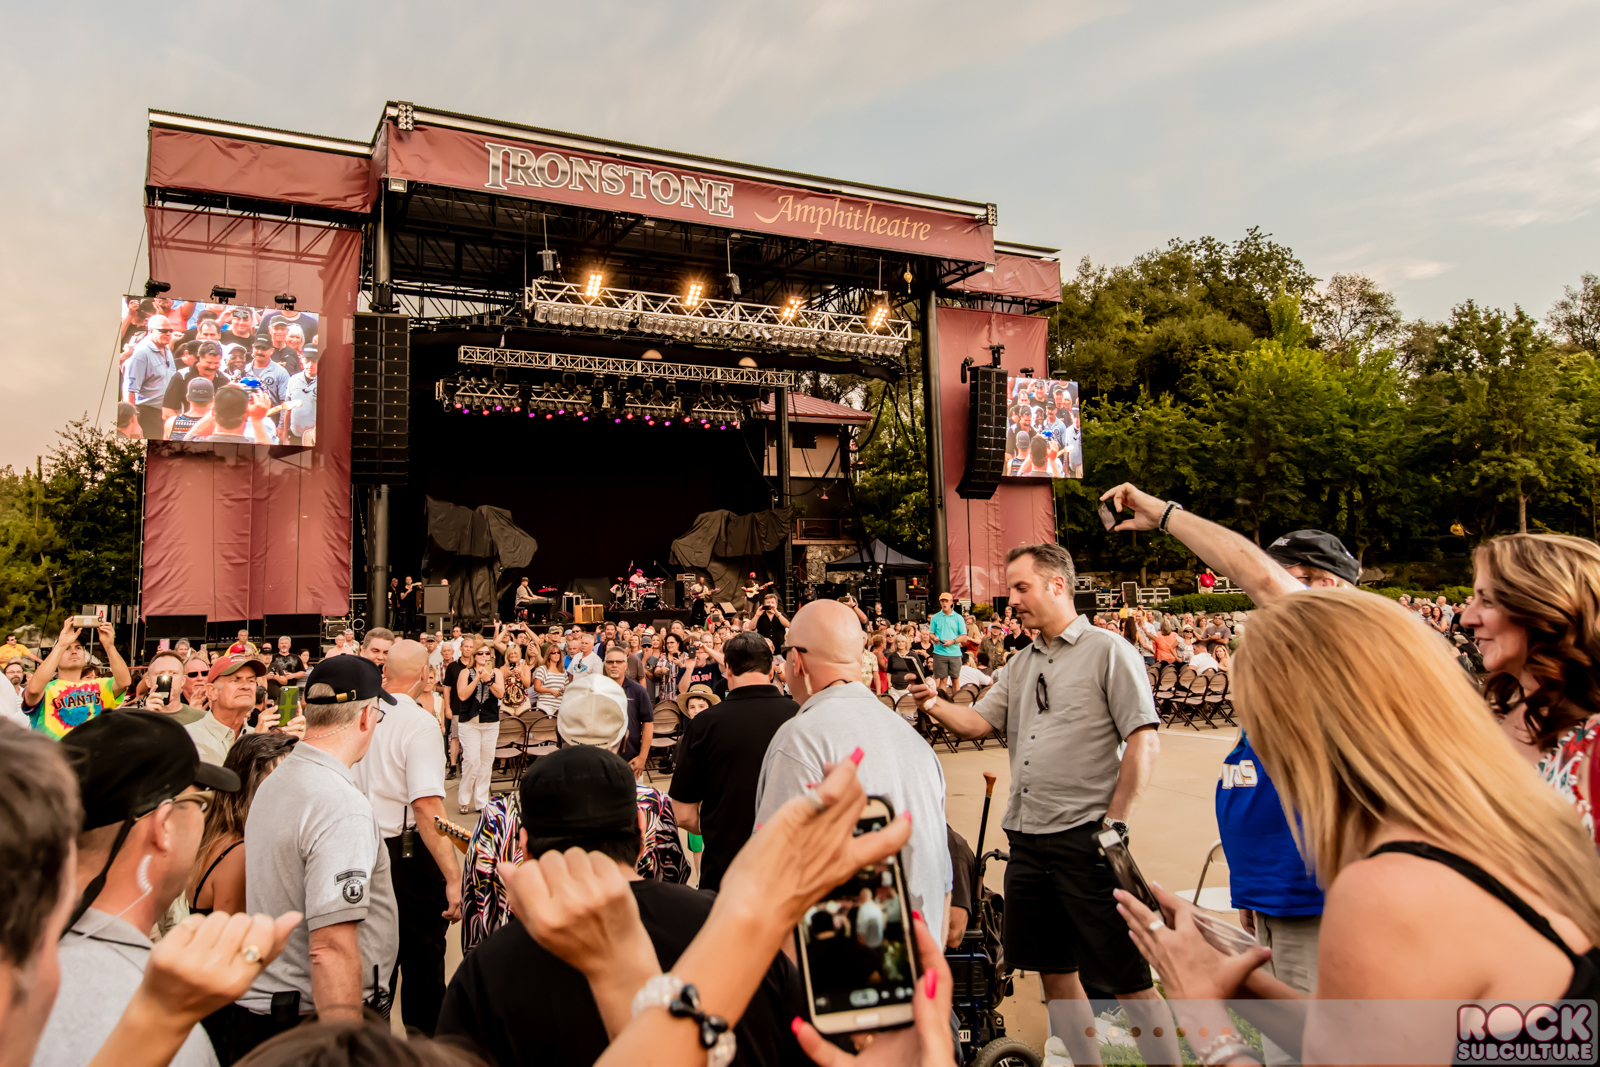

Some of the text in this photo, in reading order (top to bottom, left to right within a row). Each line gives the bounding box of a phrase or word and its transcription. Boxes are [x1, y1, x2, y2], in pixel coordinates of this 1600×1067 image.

[485, 142, 931, 241] IRONSTONE Amphitheatre
[52, 692, 101, 710] GIANTS
[349, 886, 359, 897] L
